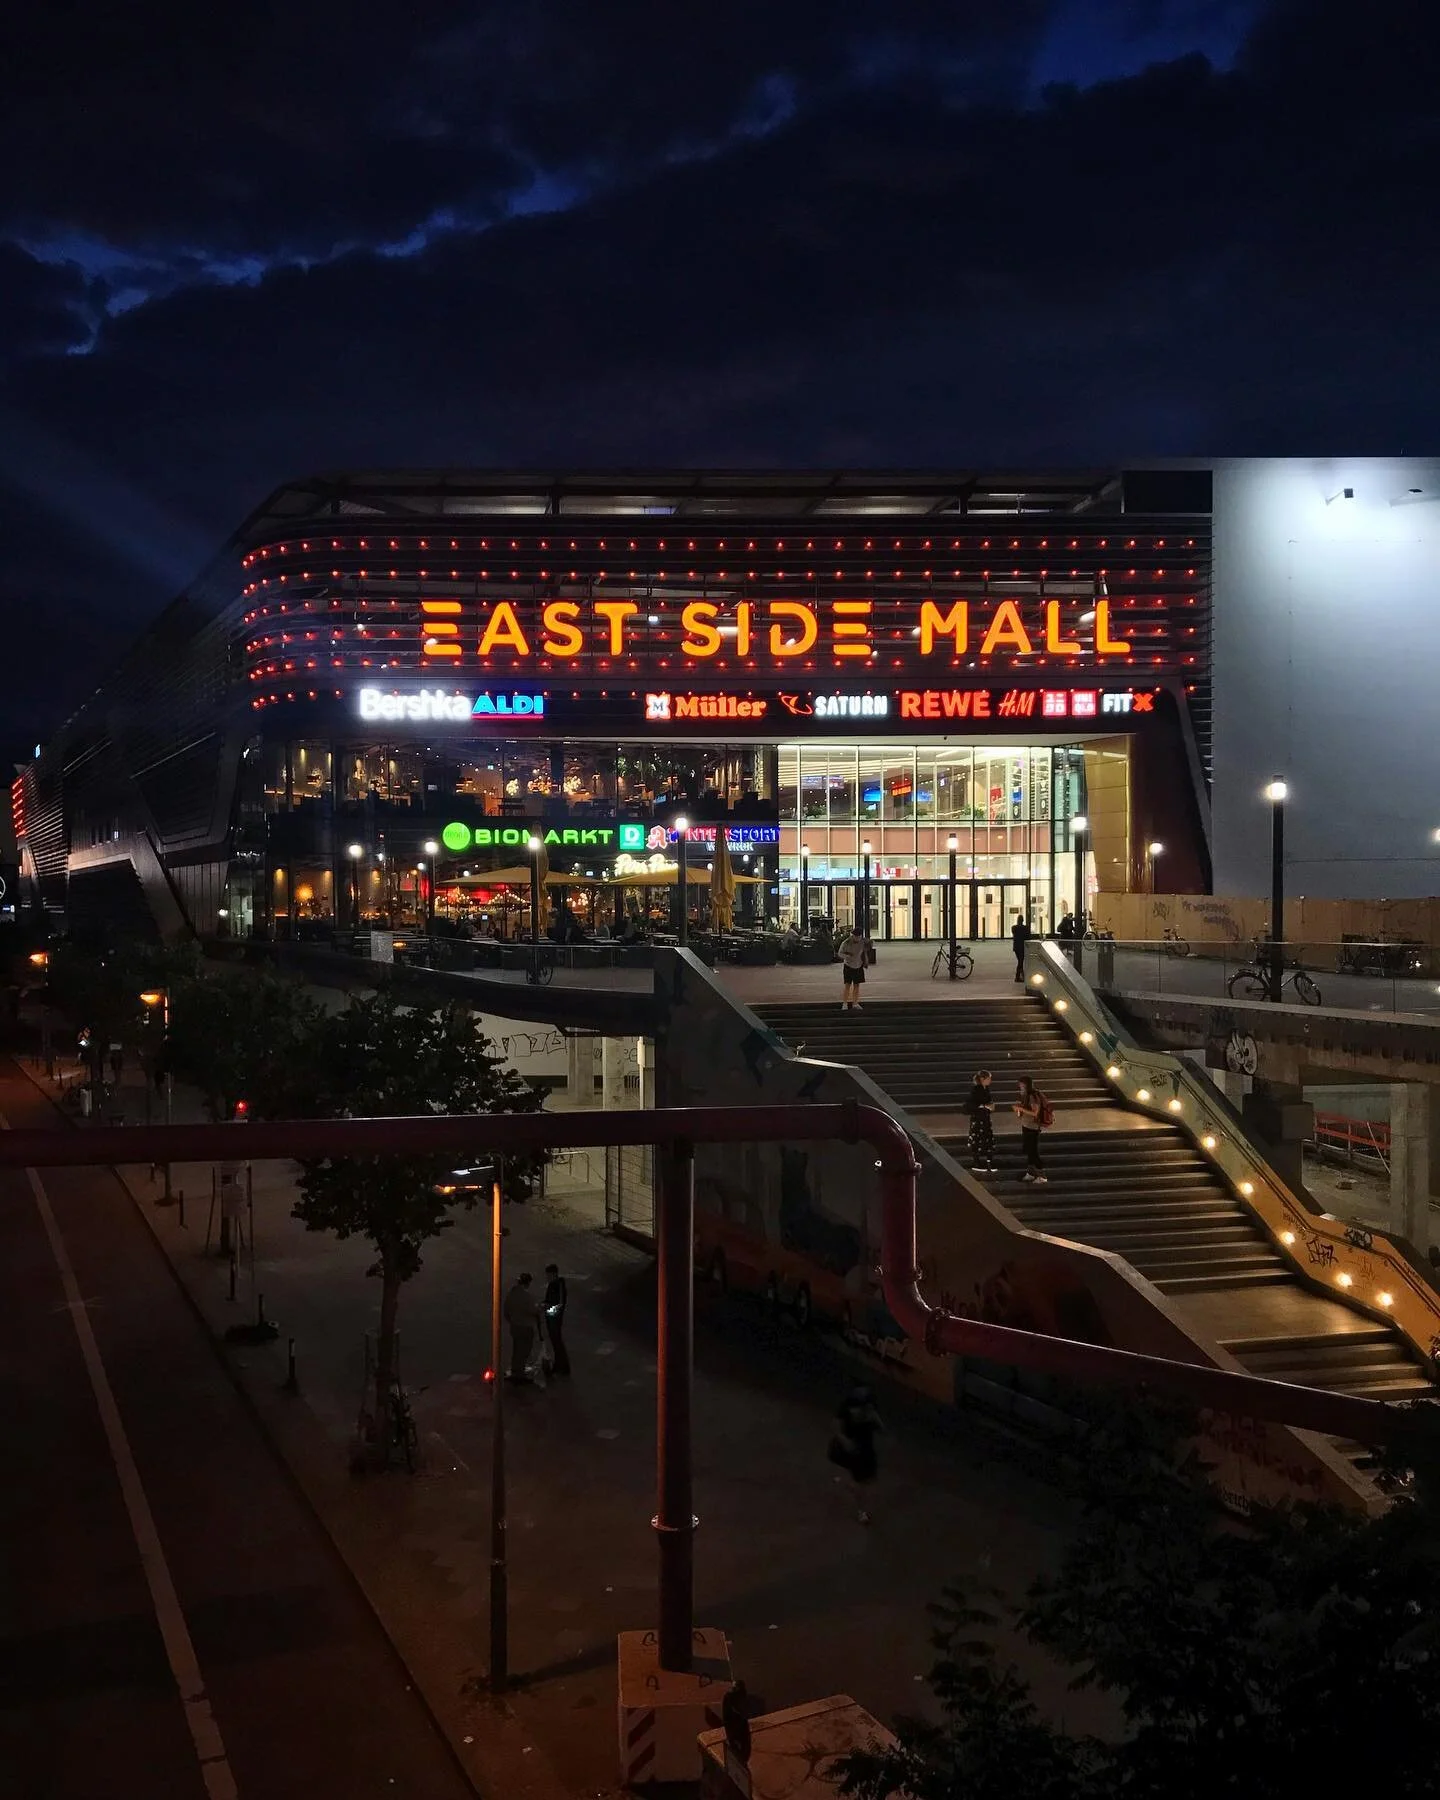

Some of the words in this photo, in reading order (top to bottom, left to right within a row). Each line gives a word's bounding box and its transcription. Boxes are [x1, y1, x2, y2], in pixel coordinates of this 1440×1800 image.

[422, 601, 639, 656] EAST
[681, 601, 872, 656] SIDE
[920, 600, 1131, 655] MALL
[360, 688, 470, 719] Bershka
[472, 695, 544, 714] ALDI
[675, 695, 766, 718] Müller
[814, 695, 888, 716] SATURN
[901, 692, 991, 718] REWE
[998, 691, 1035, 717] H&M
[1103, 693, 1153, 713] FITX
